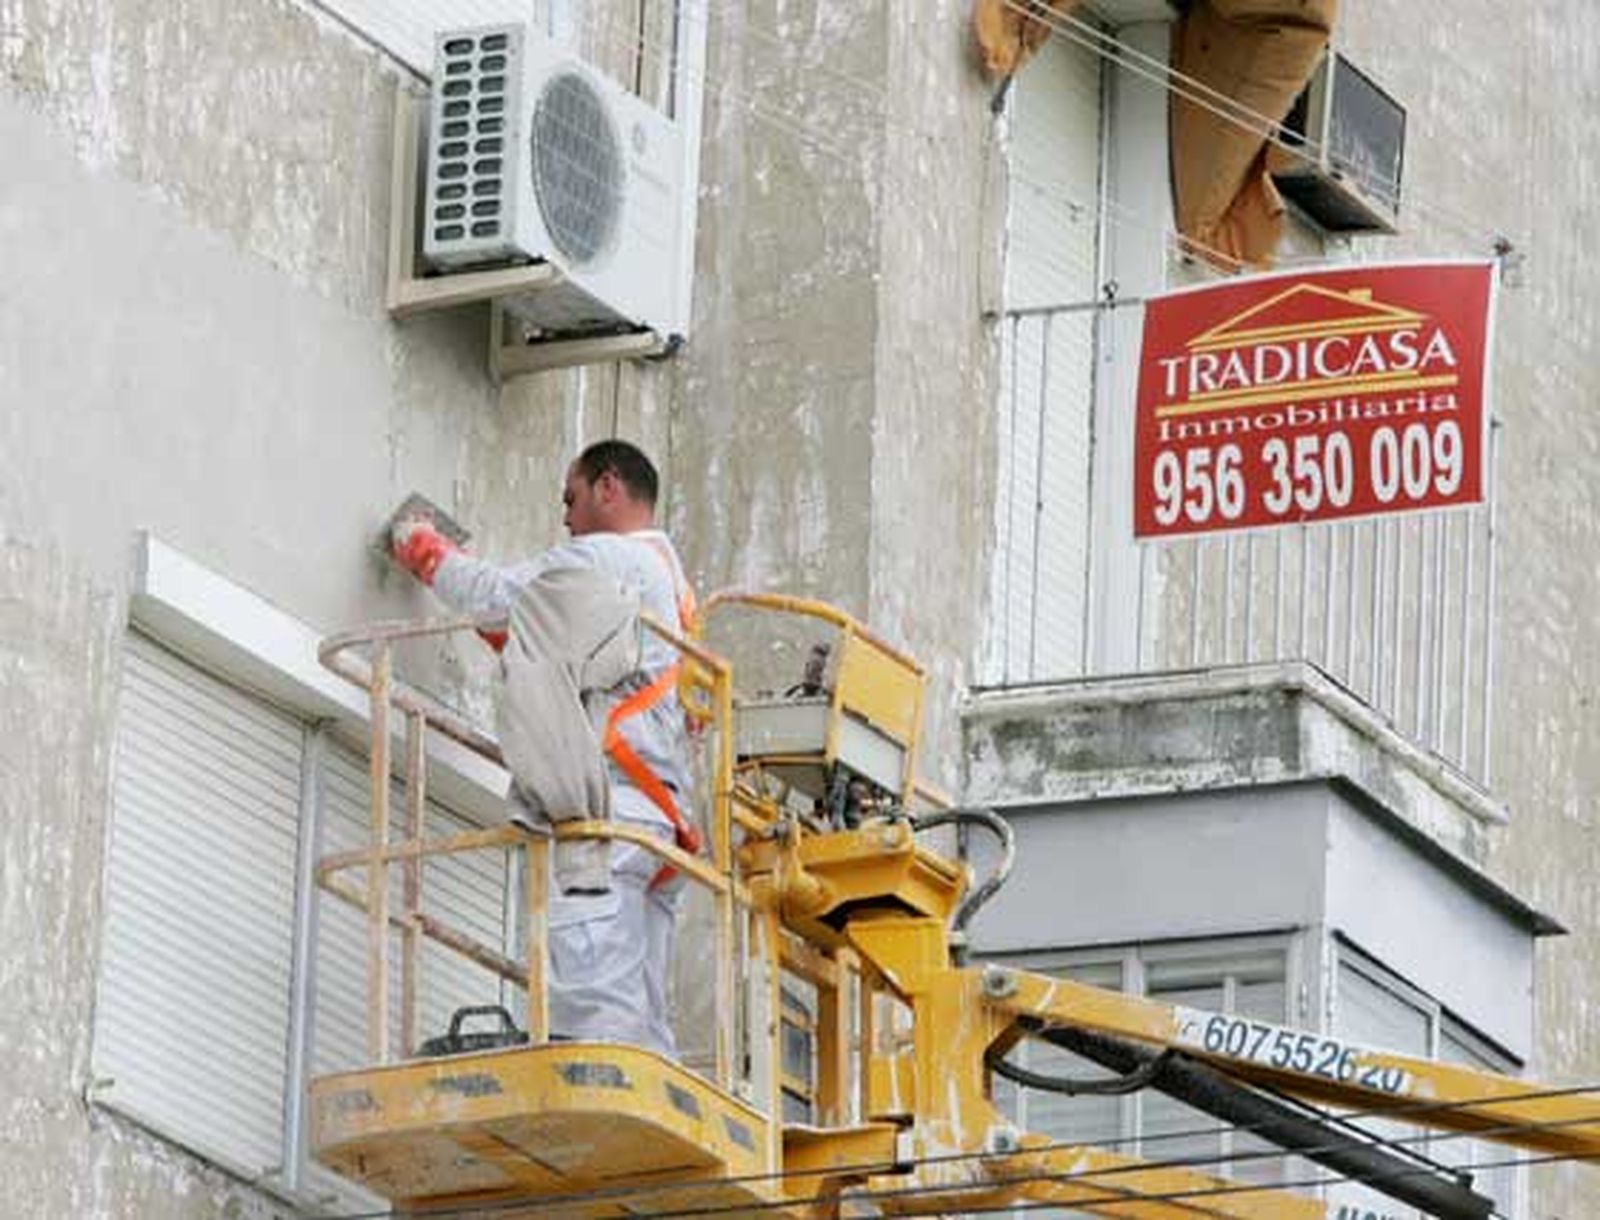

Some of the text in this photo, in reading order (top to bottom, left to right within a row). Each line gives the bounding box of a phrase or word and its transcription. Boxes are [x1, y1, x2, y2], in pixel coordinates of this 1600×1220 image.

[1159, 329, 1457, 396] TRADICASA
[1159, 392, 1458, 441] Inmobiliaria
[1153, 420, 1463, 525] 956 350 009
